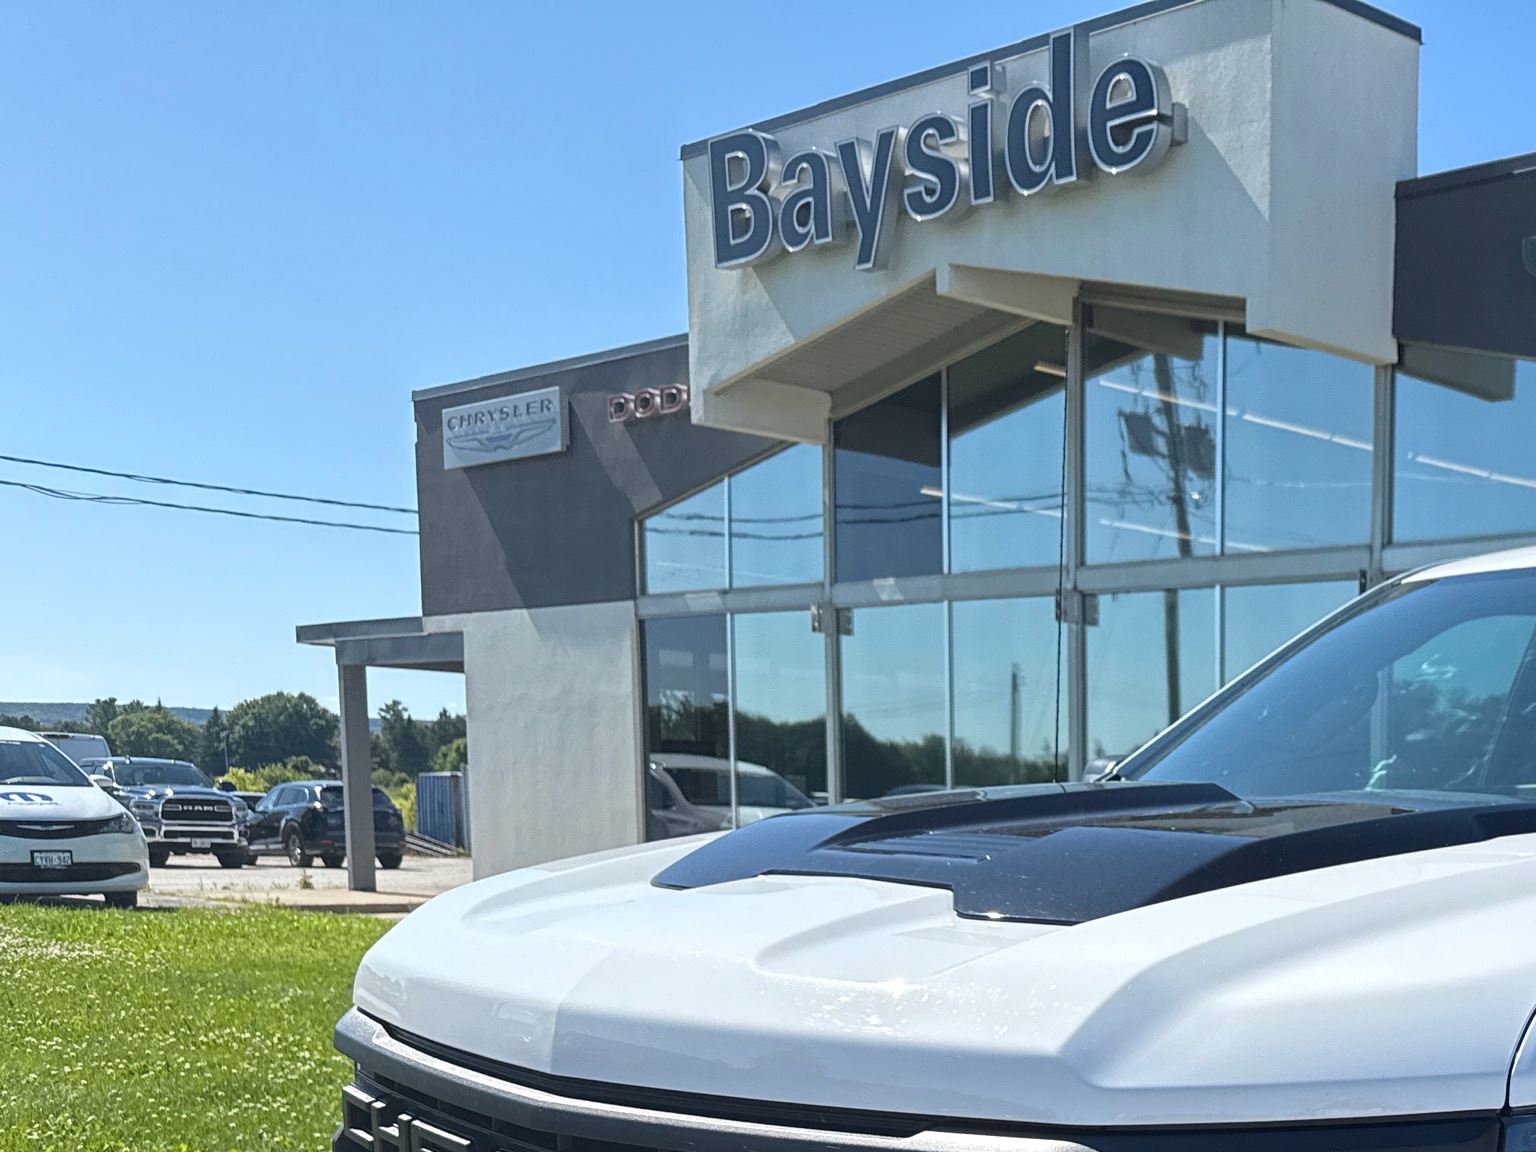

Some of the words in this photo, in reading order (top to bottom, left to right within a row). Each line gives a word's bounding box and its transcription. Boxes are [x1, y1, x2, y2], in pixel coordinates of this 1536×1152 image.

[707, 27, 1163, 270] Bayside
[447, 398, 553, 432] CHRYSLER
[608, 384, 691, 423] DOD
[183, 804, 214, 812] RAM
